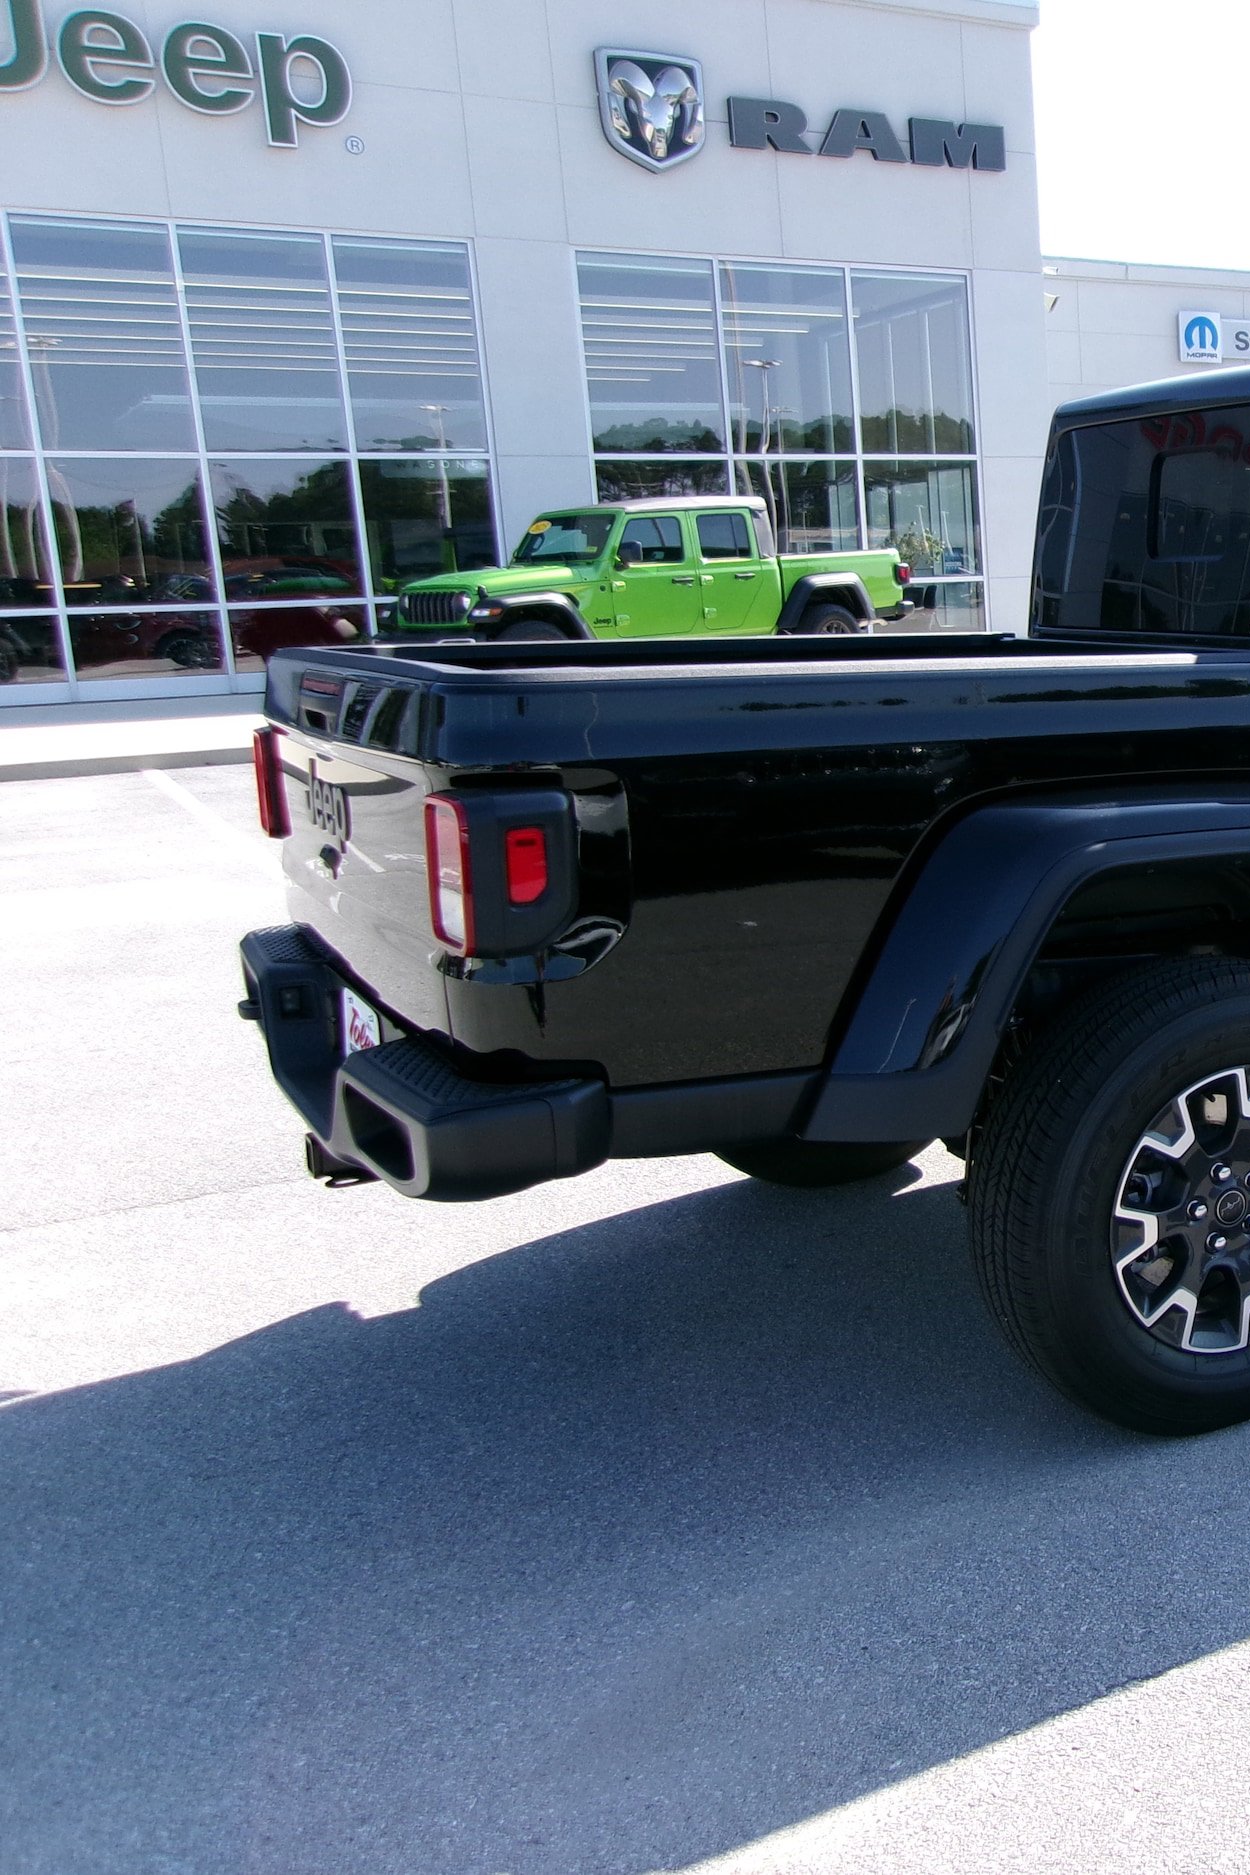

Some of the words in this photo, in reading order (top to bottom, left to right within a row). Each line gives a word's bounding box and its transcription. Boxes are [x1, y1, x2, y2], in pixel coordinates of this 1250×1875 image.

[0, 0, 353, 148] Jeep
[727, 96, 1006, 171] RAM
[1186, 352, 1218, 360] MOPAR
[593, 617, 612, 625] Jeep
[305, 758, 353, 854] Jeep
